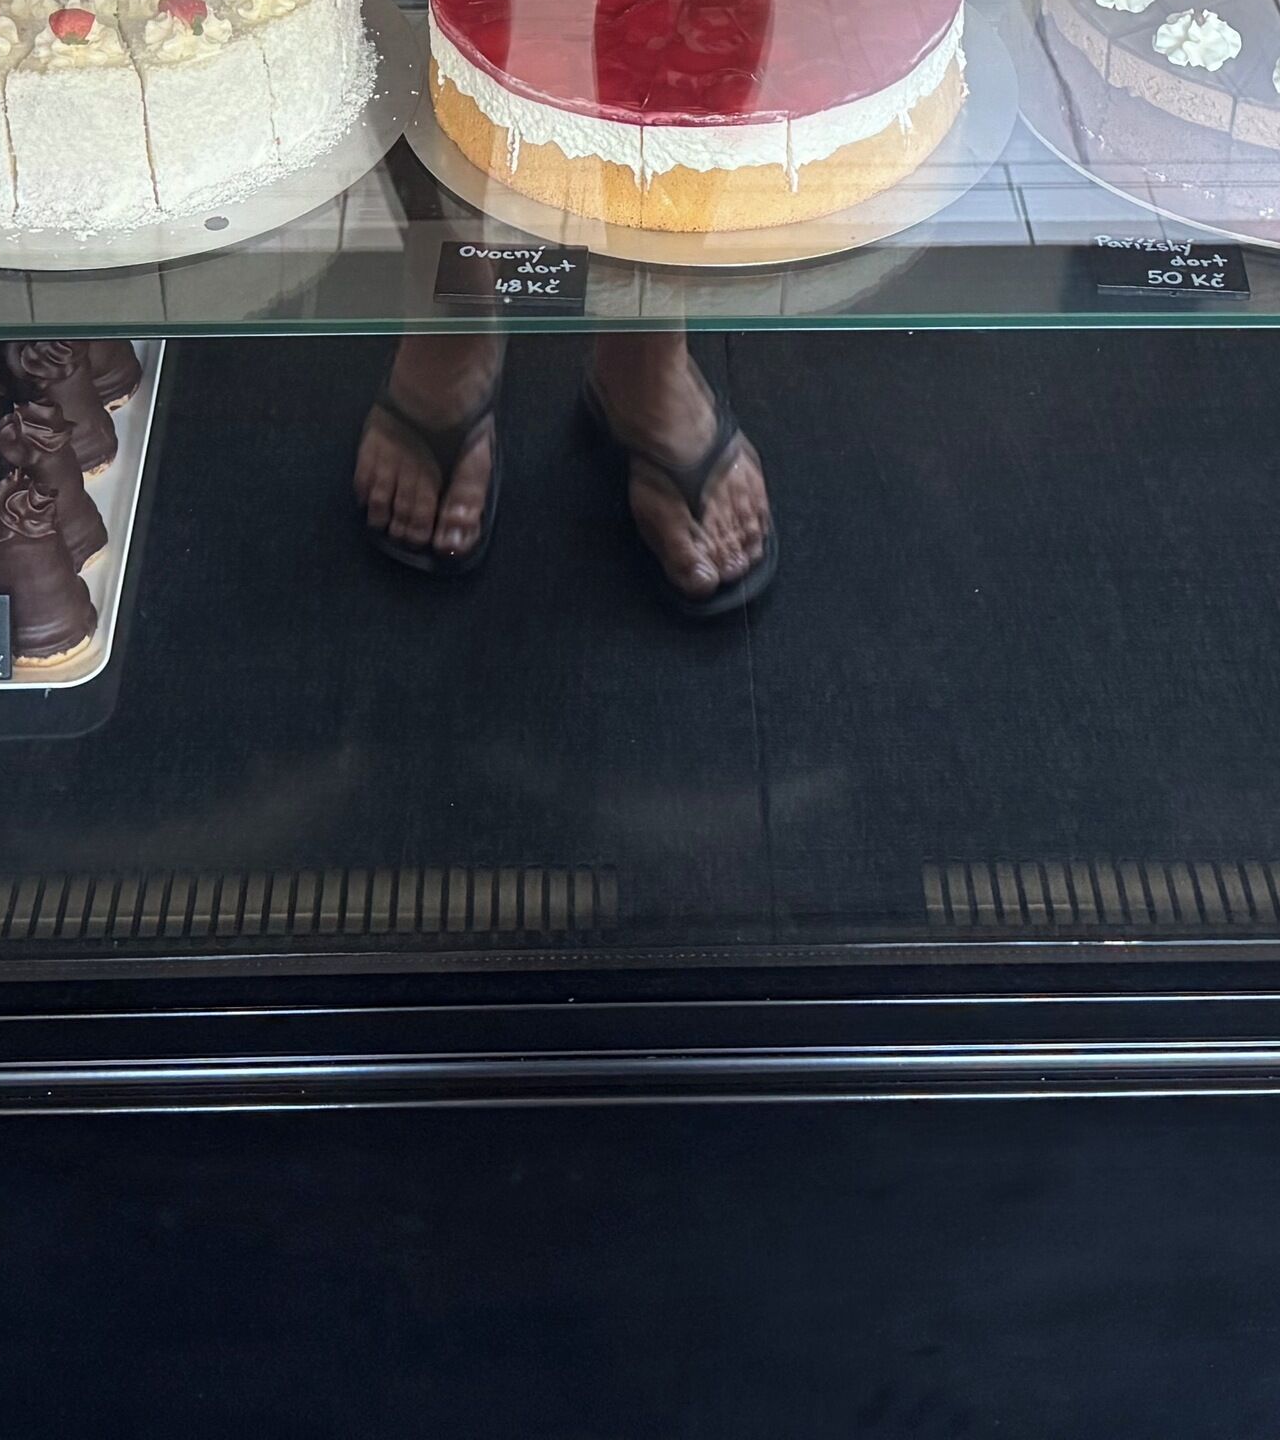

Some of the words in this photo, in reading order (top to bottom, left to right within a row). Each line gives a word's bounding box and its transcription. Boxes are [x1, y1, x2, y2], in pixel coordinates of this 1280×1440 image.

[458, 245, 547, 264] Ovocný
[1094, 234, 1195, 257] Pařížský
[516, 259, 577, 274] dort
[1169, 253, 1228, 268] dort
[494, 278, 523, 294] 48
[527, 278, 561, 295] Kč
[1147, 269, 1183, 285] 50
[1190, 272, 1226, 289] Kč
